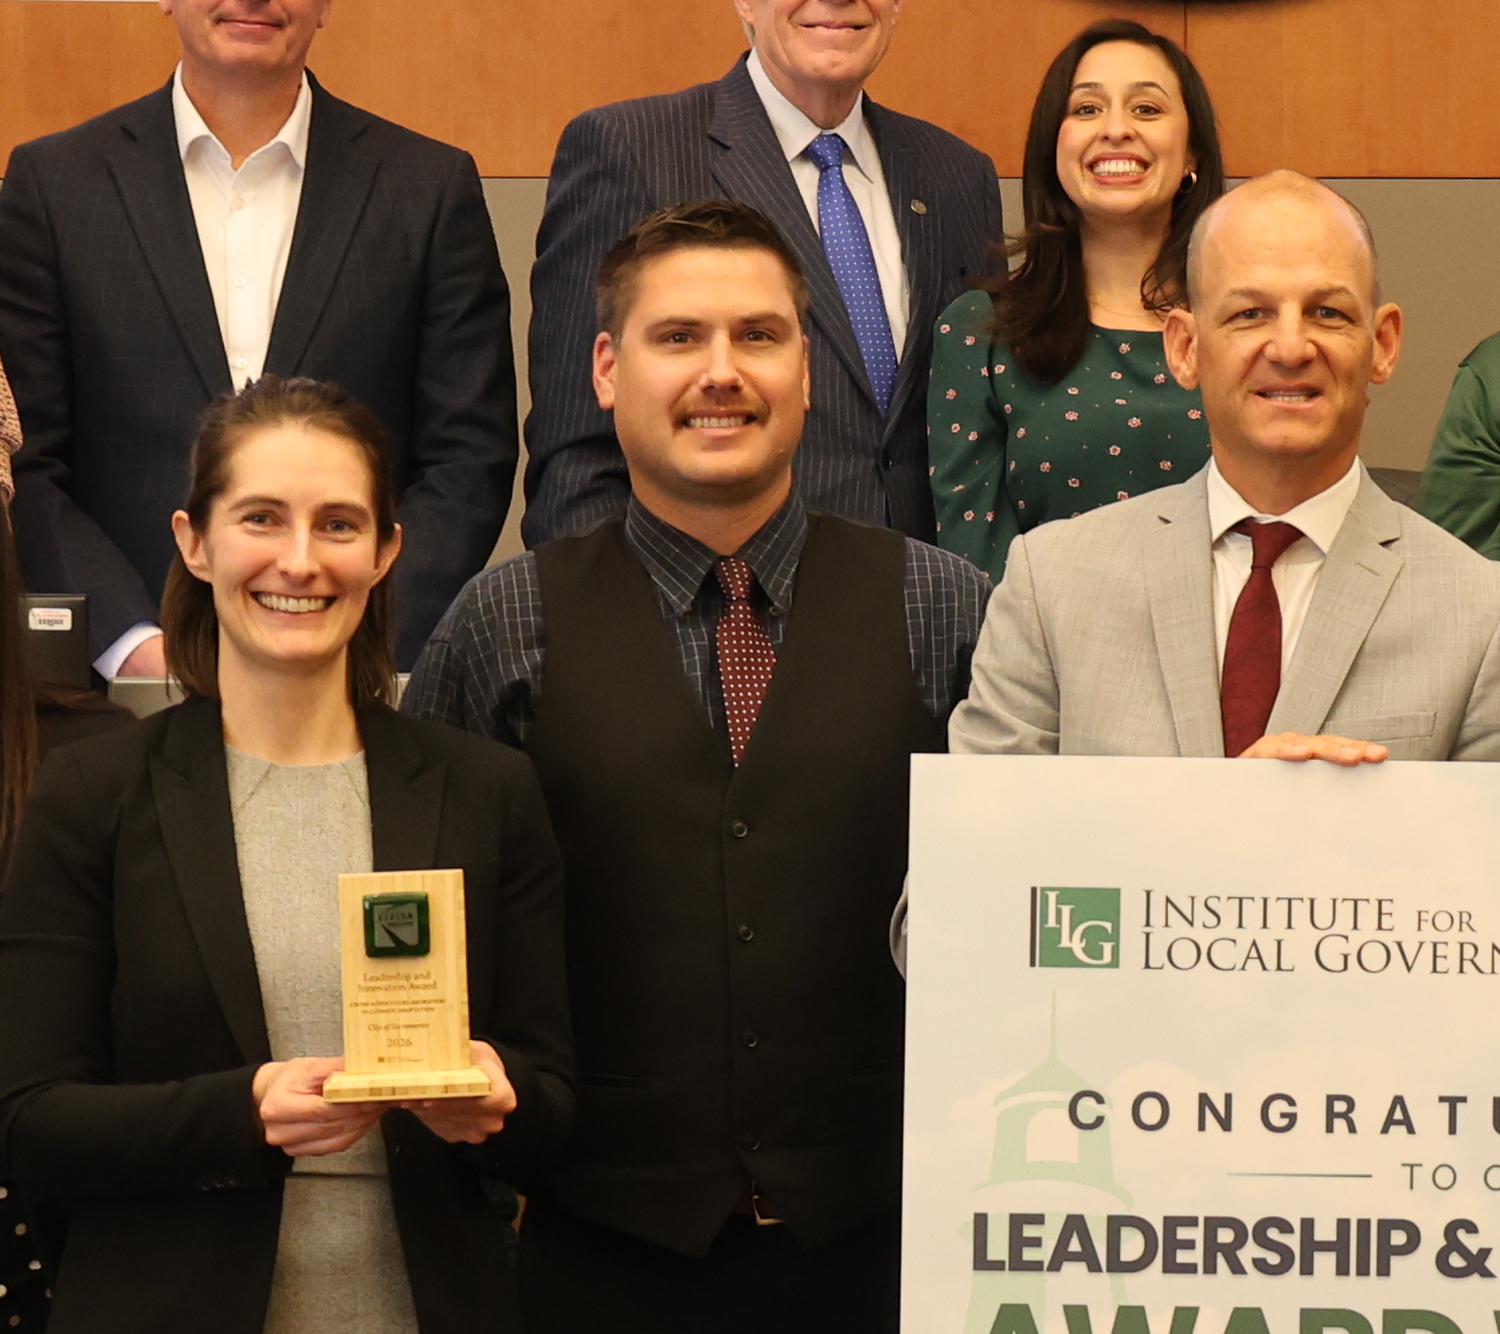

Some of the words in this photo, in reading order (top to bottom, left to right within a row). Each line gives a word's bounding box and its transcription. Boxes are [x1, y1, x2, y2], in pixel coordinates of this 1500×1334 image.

[1044, 890, 1116, 965] ILG
[1142, 889, 1394, 932] INSTITUTE
[1416, 910, 1477, 933] FOR
[1141, 930, 1295, 972] LOCAL
[1400, 1163, 1457, 1191] TO
[972, 1212, 1422, 1278] LEADERSHIP
[1434, 1218, 1497, 1279] &
